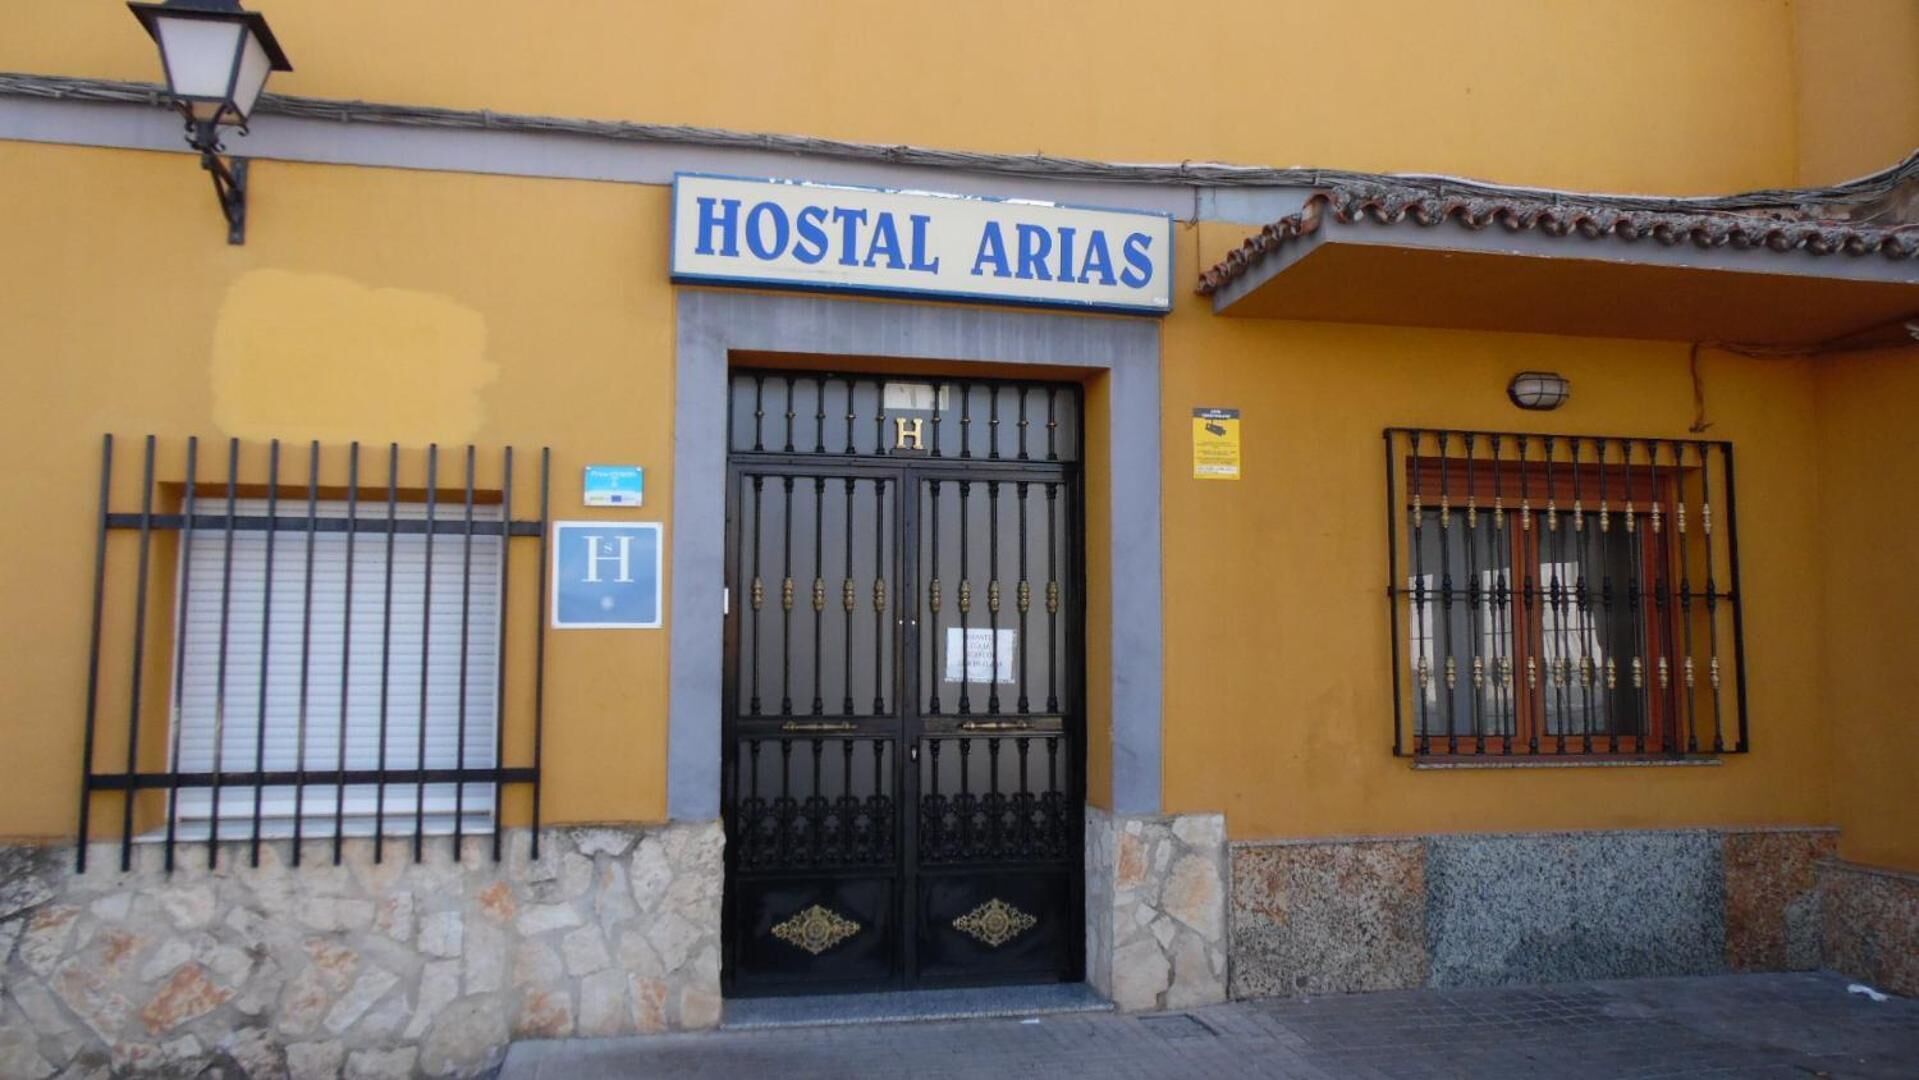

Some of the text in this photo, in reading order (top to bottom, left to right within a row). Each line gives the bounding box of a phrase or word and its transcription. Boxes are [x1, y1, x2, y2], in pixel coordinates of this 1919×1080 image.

[695, 197, 1153, 289] HOSTAL ARIAS
[896, 417, 923, 449] H
[581, 535, 635, 583] H
